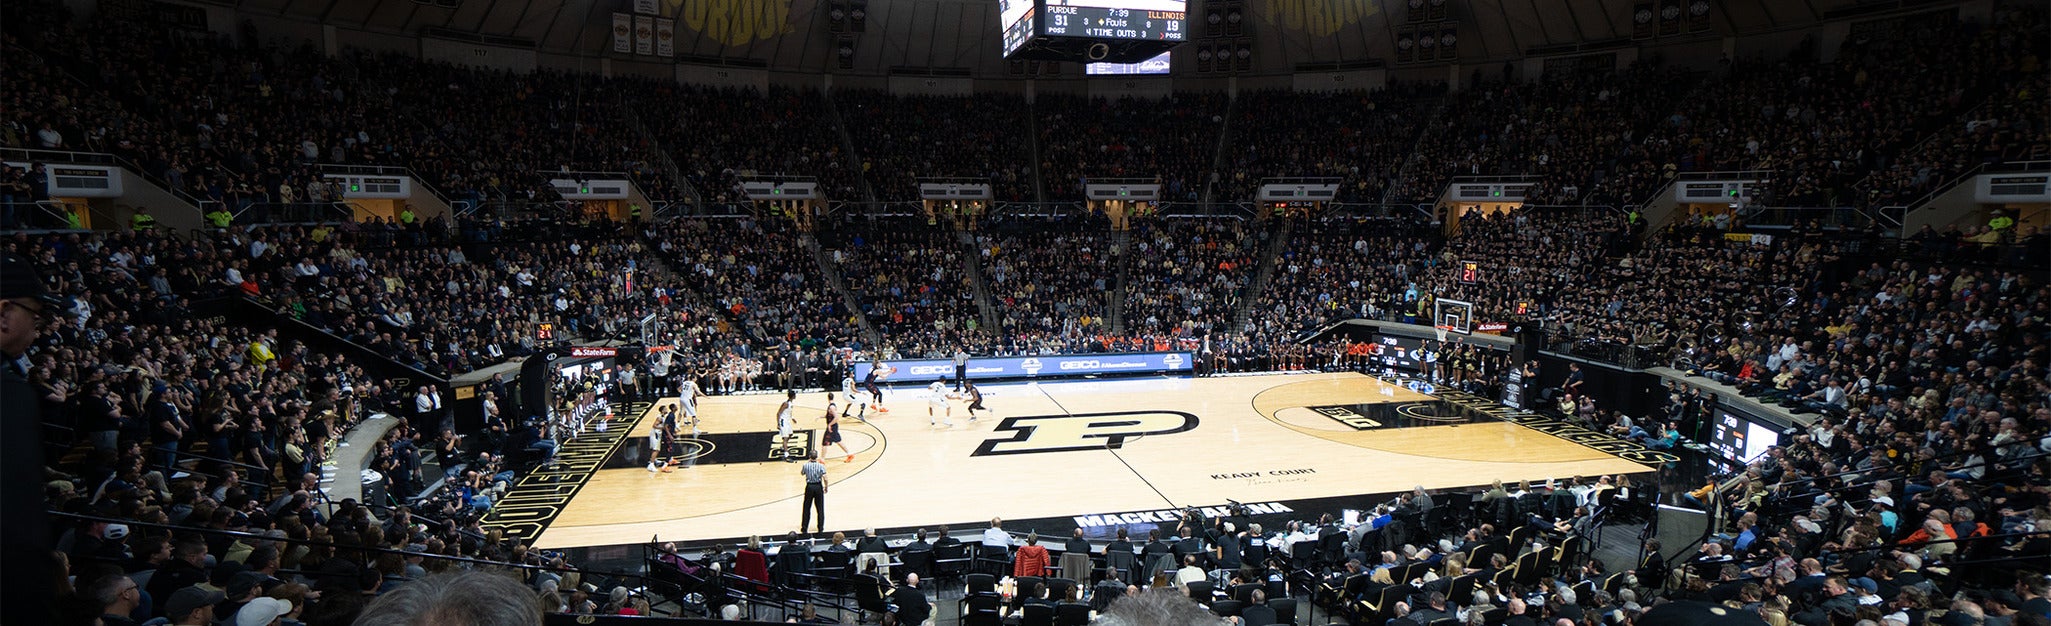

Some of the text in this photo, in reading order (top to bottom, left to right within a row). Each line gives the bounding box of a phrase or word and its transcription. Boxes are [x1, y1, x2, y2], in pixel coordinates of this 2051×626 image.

[1047, 6, 1078, 14] PURDUE
[1109, 8, 1129, 17] 7:39
[1148, 11, 1185, 20] ILLINOIS
[1054, 16, 1068, 26] 31
[1106, 18, 1127, 27] Fouls
[1166, 21, 1179, 31] 19
[1086, 28, 1092, 36] 4
[1094, 29, 1115, 37] TIME
[1117, 29, 1136, 37] OUTS
[1464, 270, 1474, 281] 21
[539, 330, 550, 338] 21
[1060, 360, 1100, 369] GEICO
[910, 365, 953, 375] GEICO
[970, 410, 1200, 458] P
[1210, 468, 1317, 480] KEADY COURT
